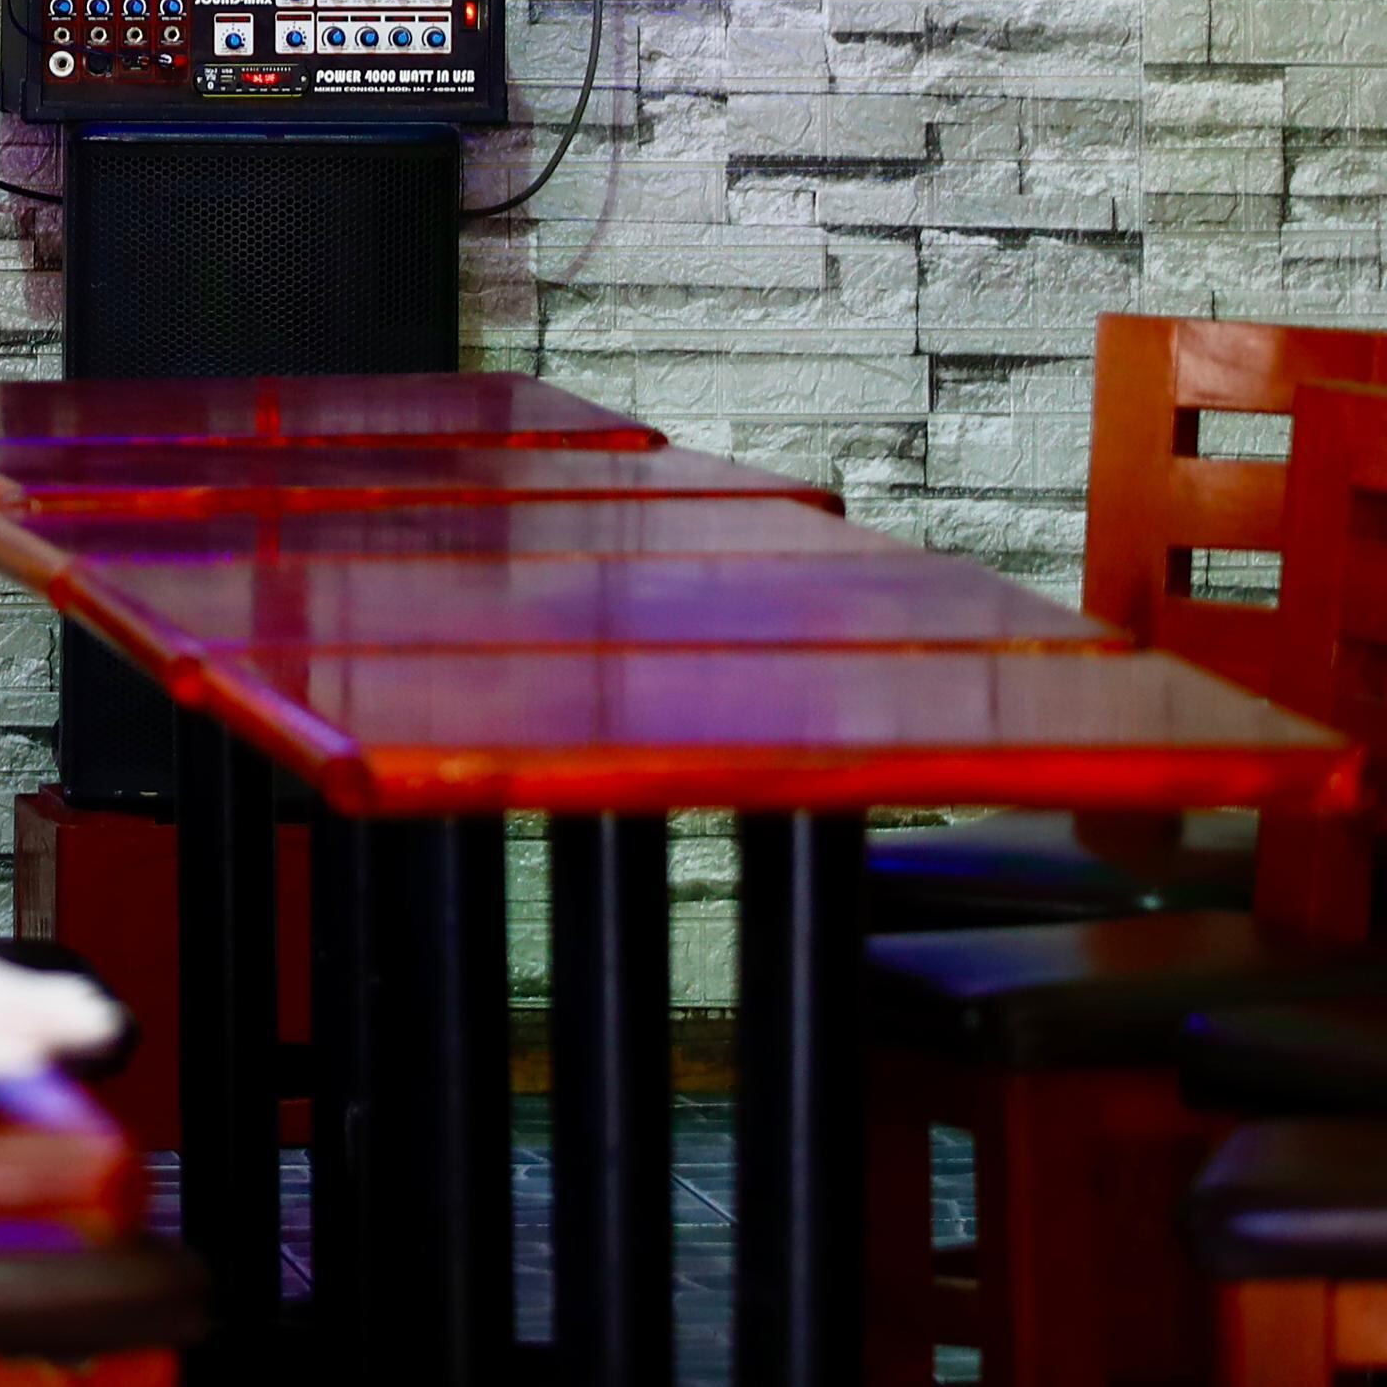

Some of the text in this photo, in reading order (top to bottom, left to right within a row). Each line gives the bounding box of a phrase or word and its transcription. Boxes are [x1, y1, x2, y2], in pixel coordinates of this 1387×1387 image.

[316, 69, 476, 84] POWER 4000 WATT IN USB
